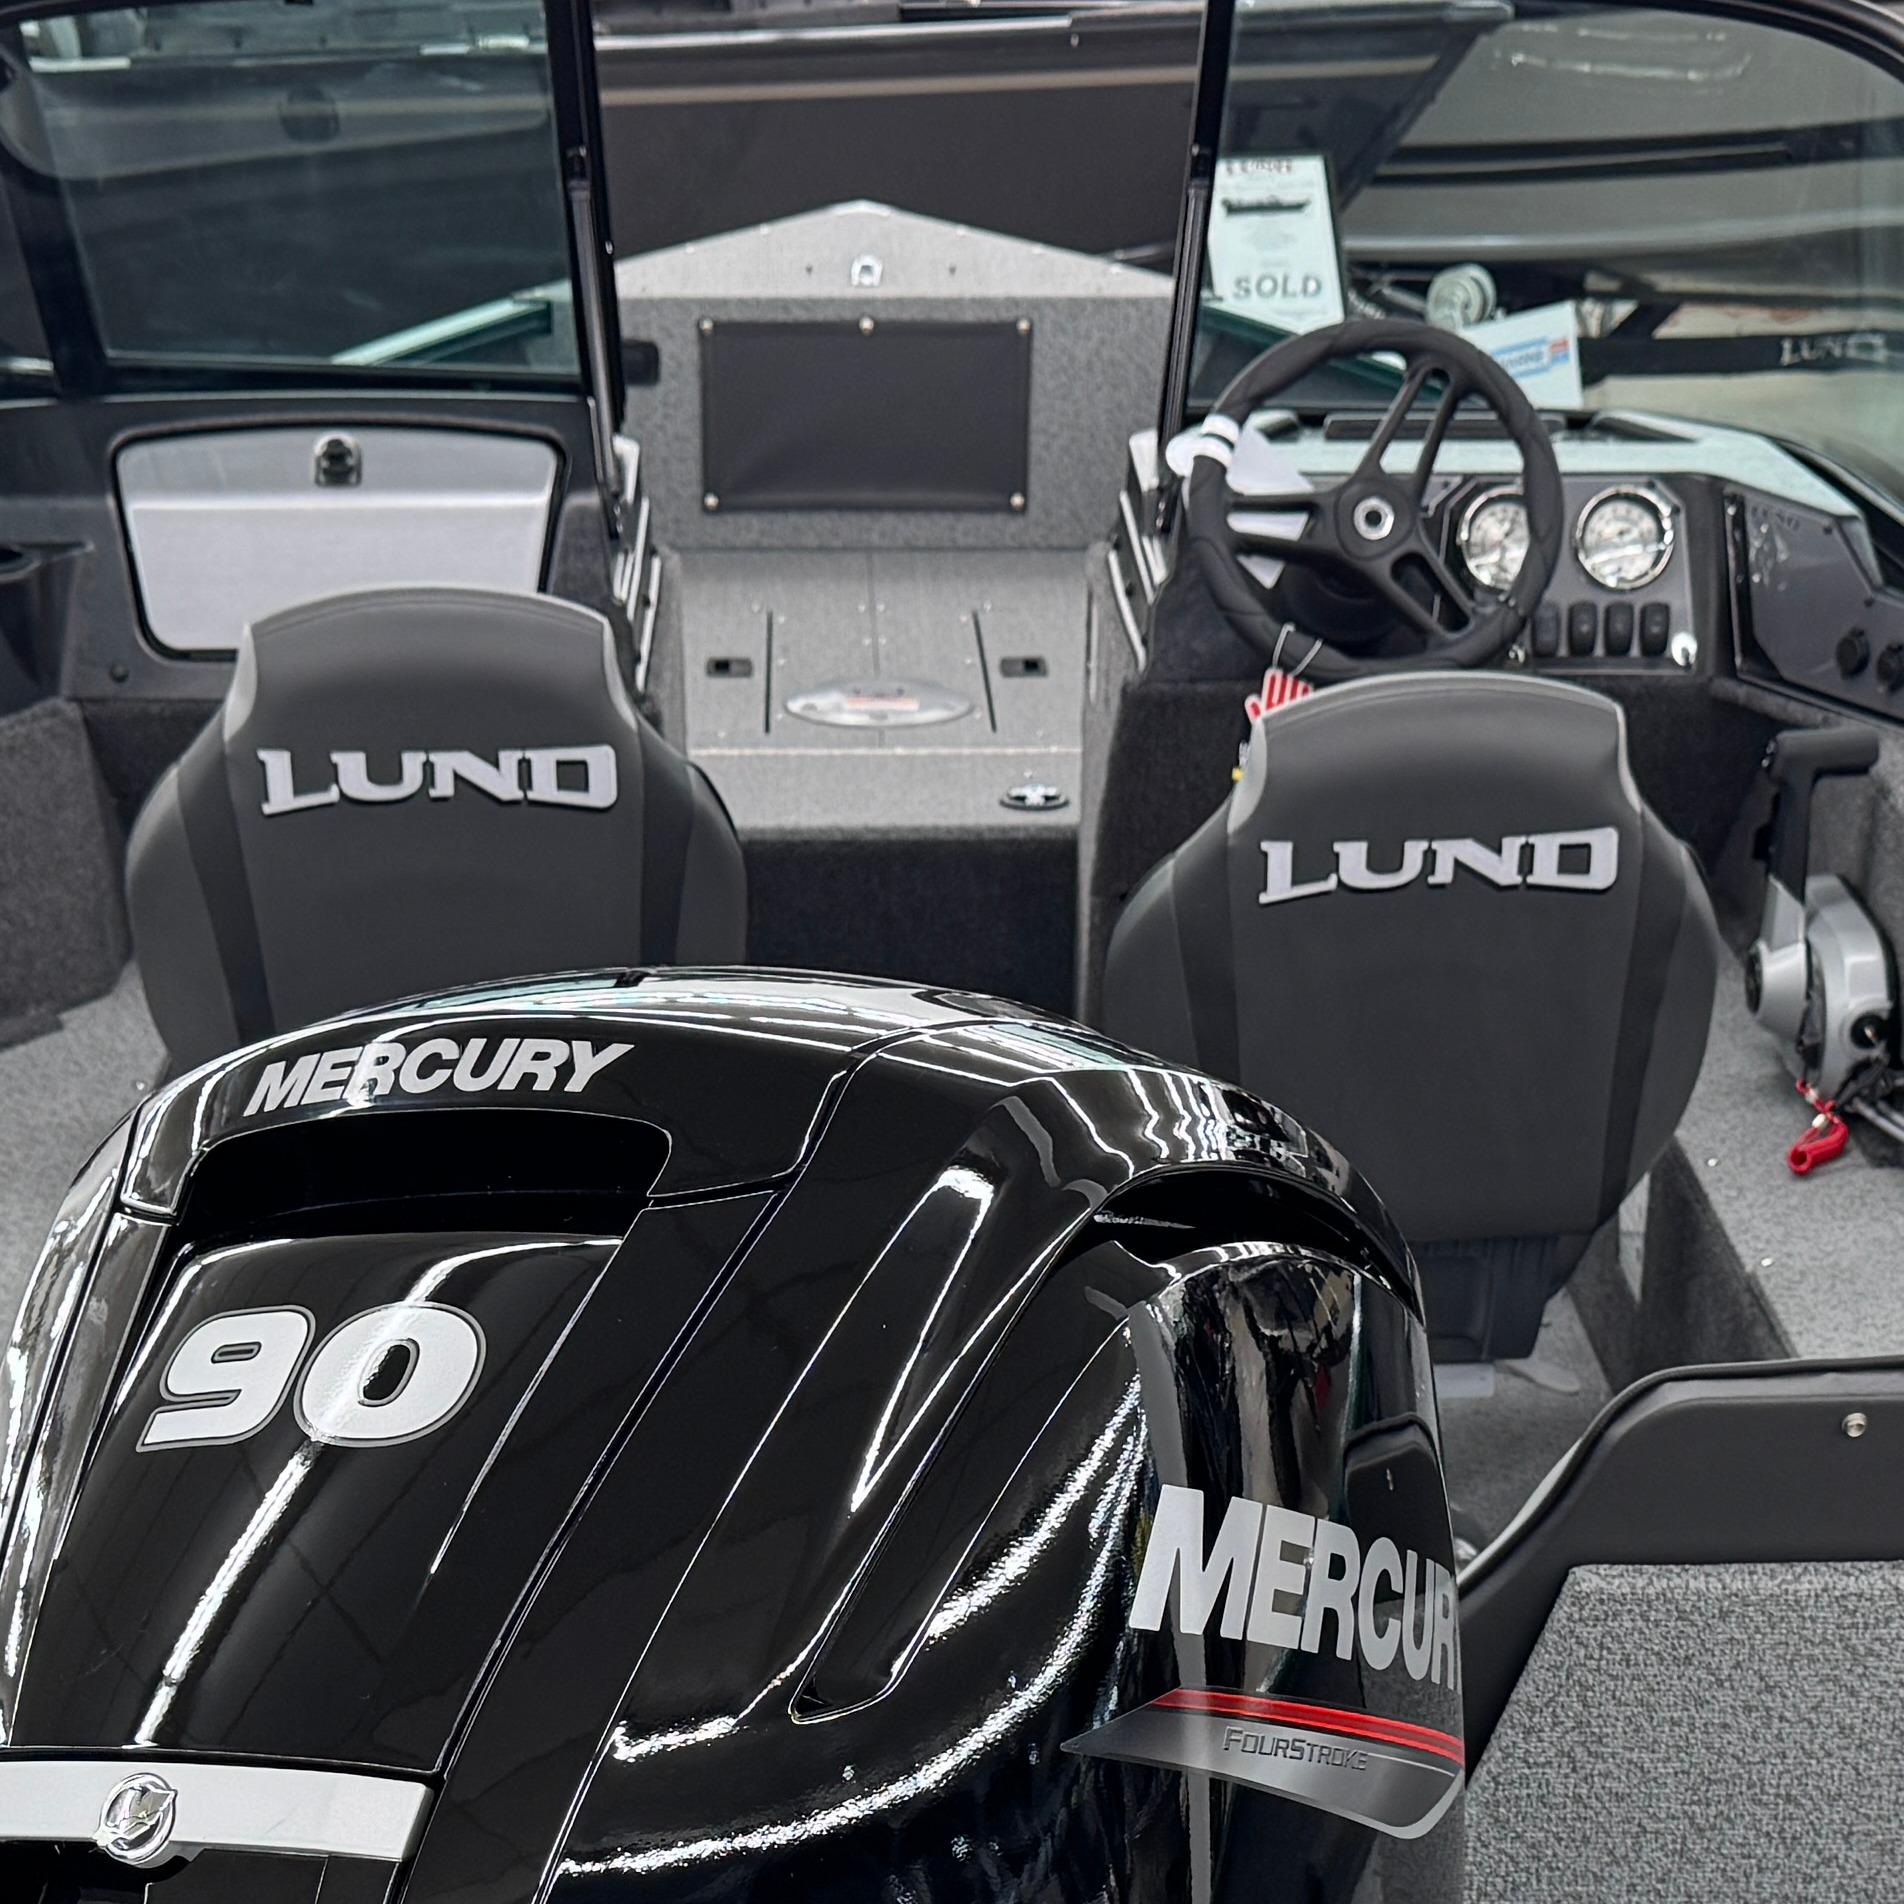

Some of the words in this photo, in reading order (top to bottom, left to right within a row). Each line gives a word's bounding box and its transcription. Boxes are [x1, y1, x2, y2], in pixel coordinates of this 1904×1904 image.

[1234, 273, 1322, 299] SOLD
[1780, 333, 1888, 366] LUND
[257, 744, 617, 816] LUND
[1259, 826, 1619, 904] LUND
[243, 1038, 634, 1117] MERCURY
[136, 1304, 487, 1452] 90
[1129, 1484, 1462, 1697] MERCUR
